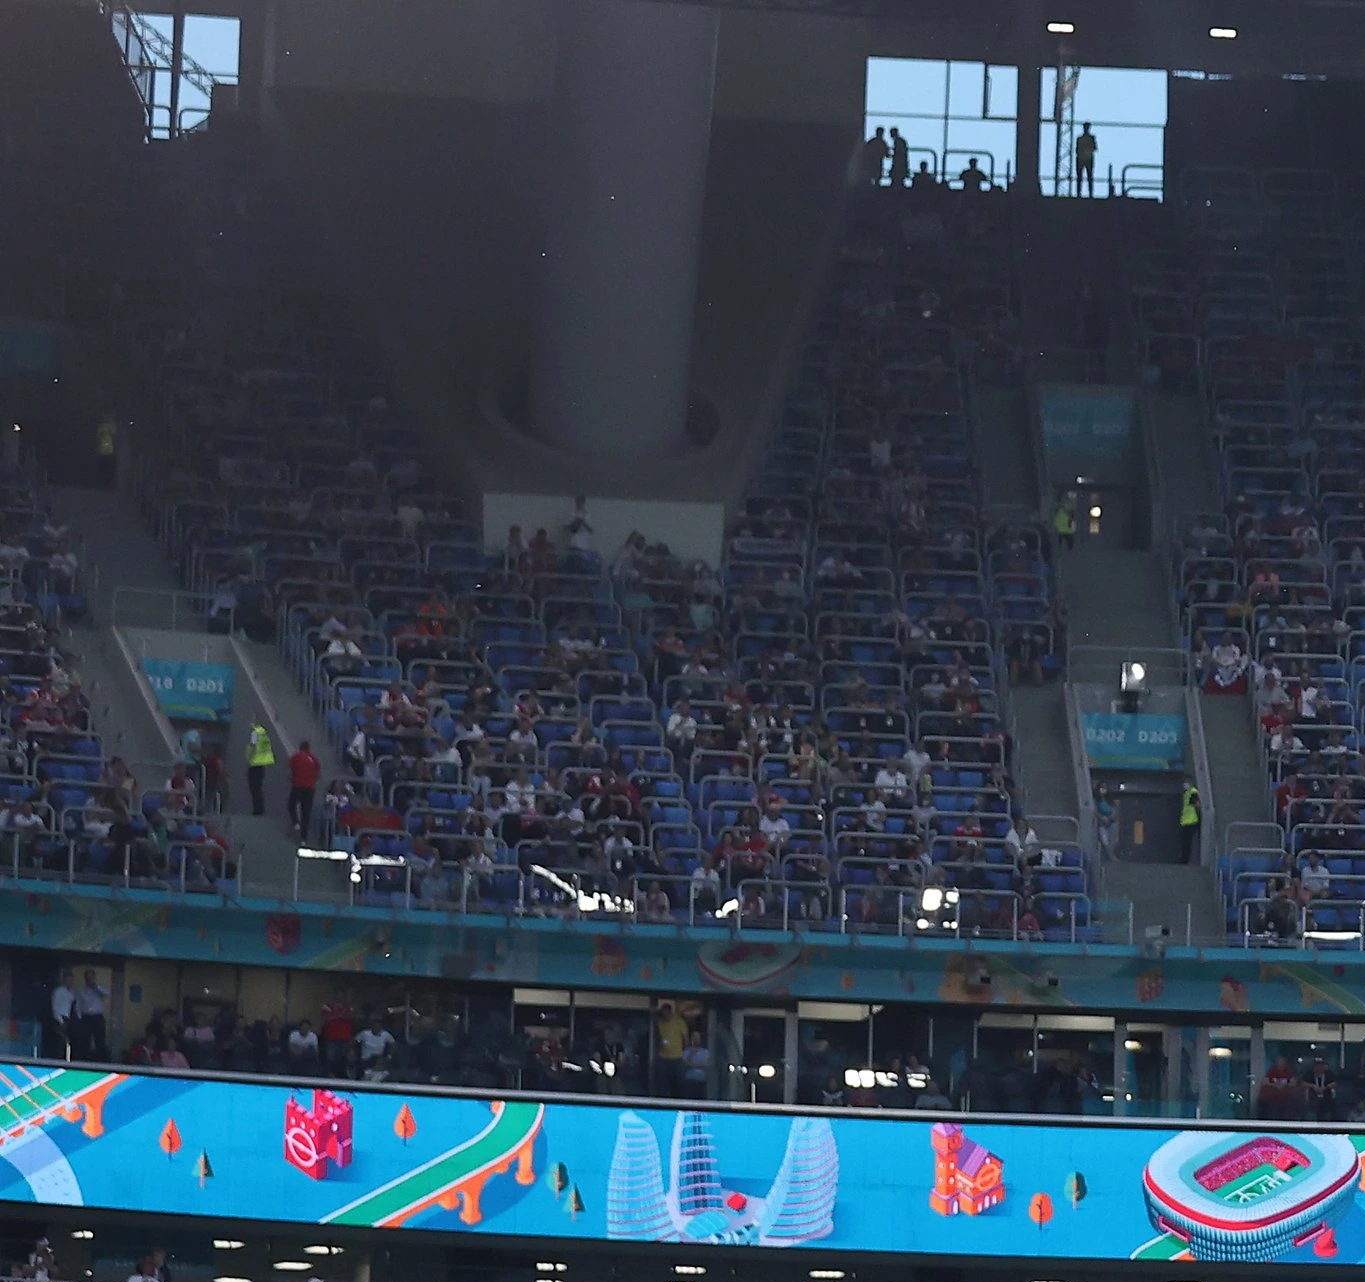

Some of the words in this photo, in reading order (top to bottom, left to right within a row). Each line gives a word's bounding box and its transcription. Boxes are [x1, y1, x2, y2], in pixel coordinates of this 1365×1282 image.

[186, 677, 225, 694] D201
[1086, 728, 1126, 743] D202
[1138, 729, 1178, 744] D203
